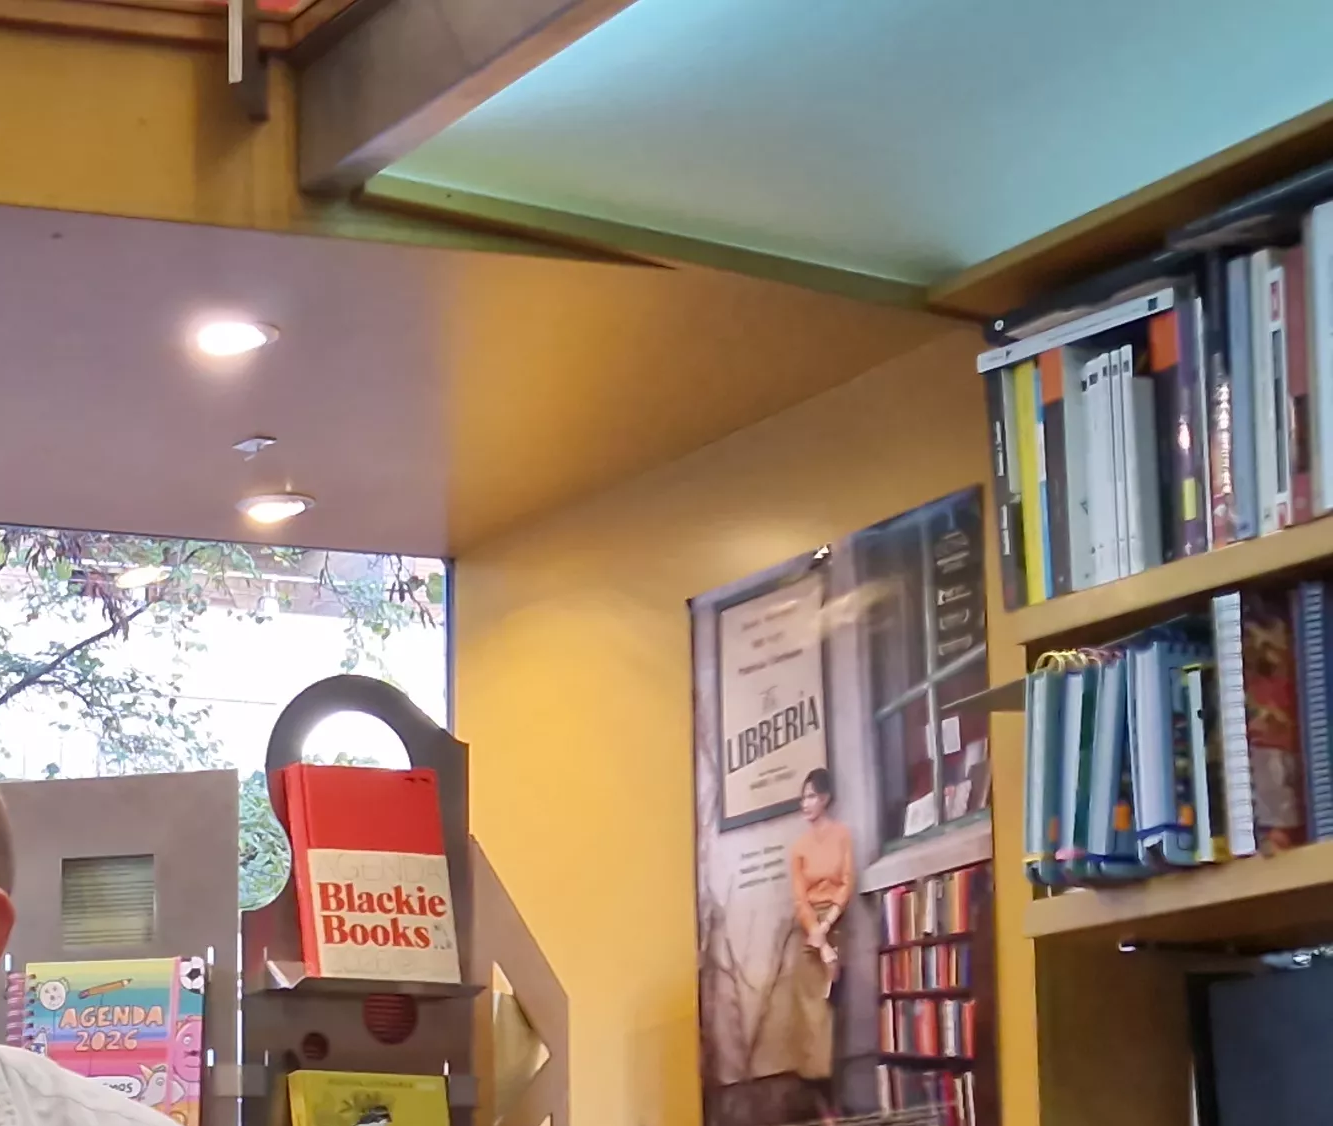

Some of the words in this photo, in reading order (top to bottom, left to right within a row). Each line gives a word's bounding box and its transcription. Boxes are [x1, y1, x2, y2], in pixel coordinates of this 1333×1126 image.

[727, 689, 820, 774] LIBRERÍA
[317, 881, 447, 918] Blackie
[321, 914, 431, 949] Books
[59, 1005, 165, 1029] AGENDA
[75, 1028, 139, 1052] 2026
